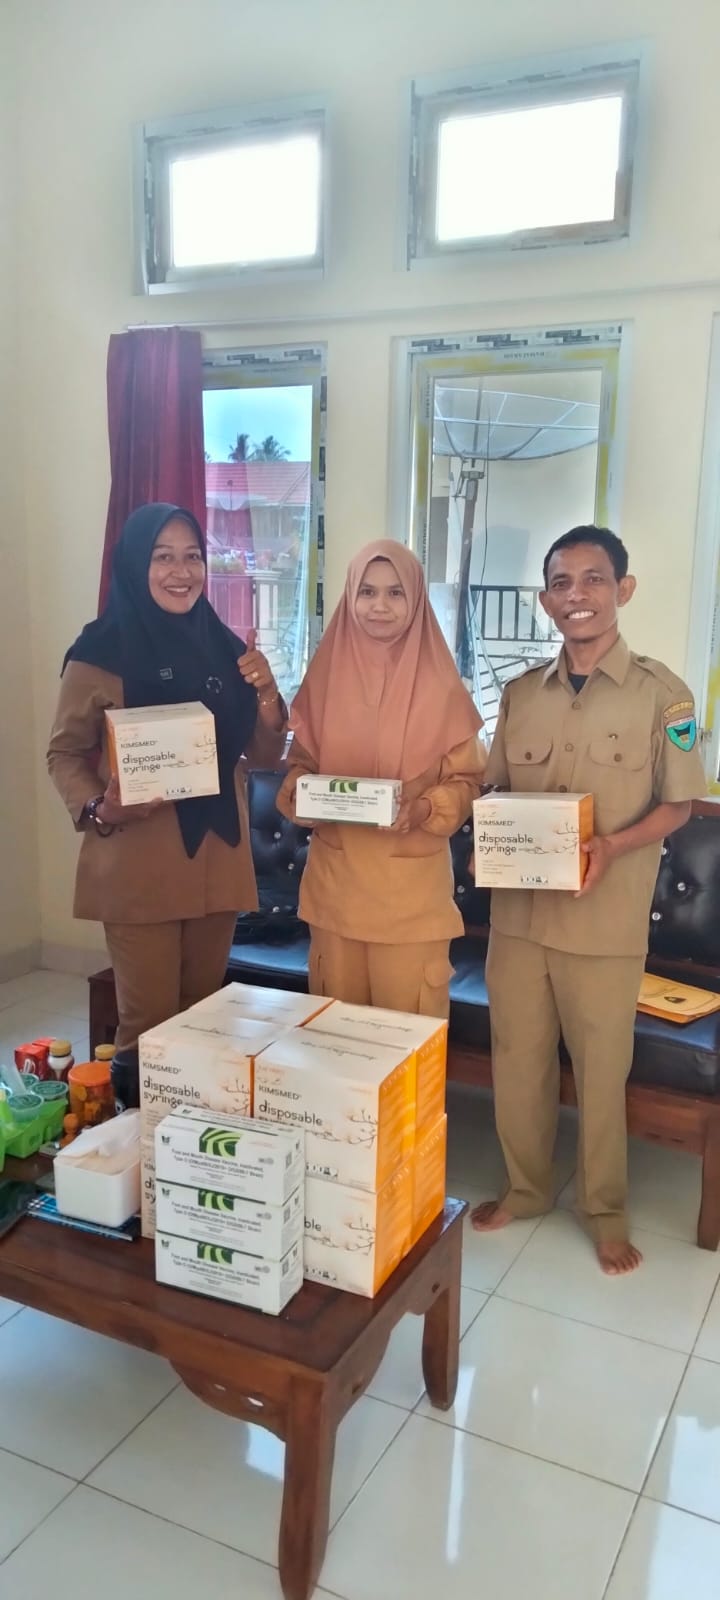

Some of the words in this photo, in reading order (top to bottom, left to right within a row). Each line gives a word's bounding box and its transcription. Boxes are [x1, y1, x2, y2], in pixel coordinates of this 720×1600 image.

[122, 751, 176, 765] disposable
[123, 763, 161, 776] syringe
[478, 832, 534, 847] disposable
[478, 845, 517, 856] syringe
[143, 1075, 201, 1099] disposable
[143, 1091, 183, 1109] syringe
[258, 1099, 323, 1126] disposable
